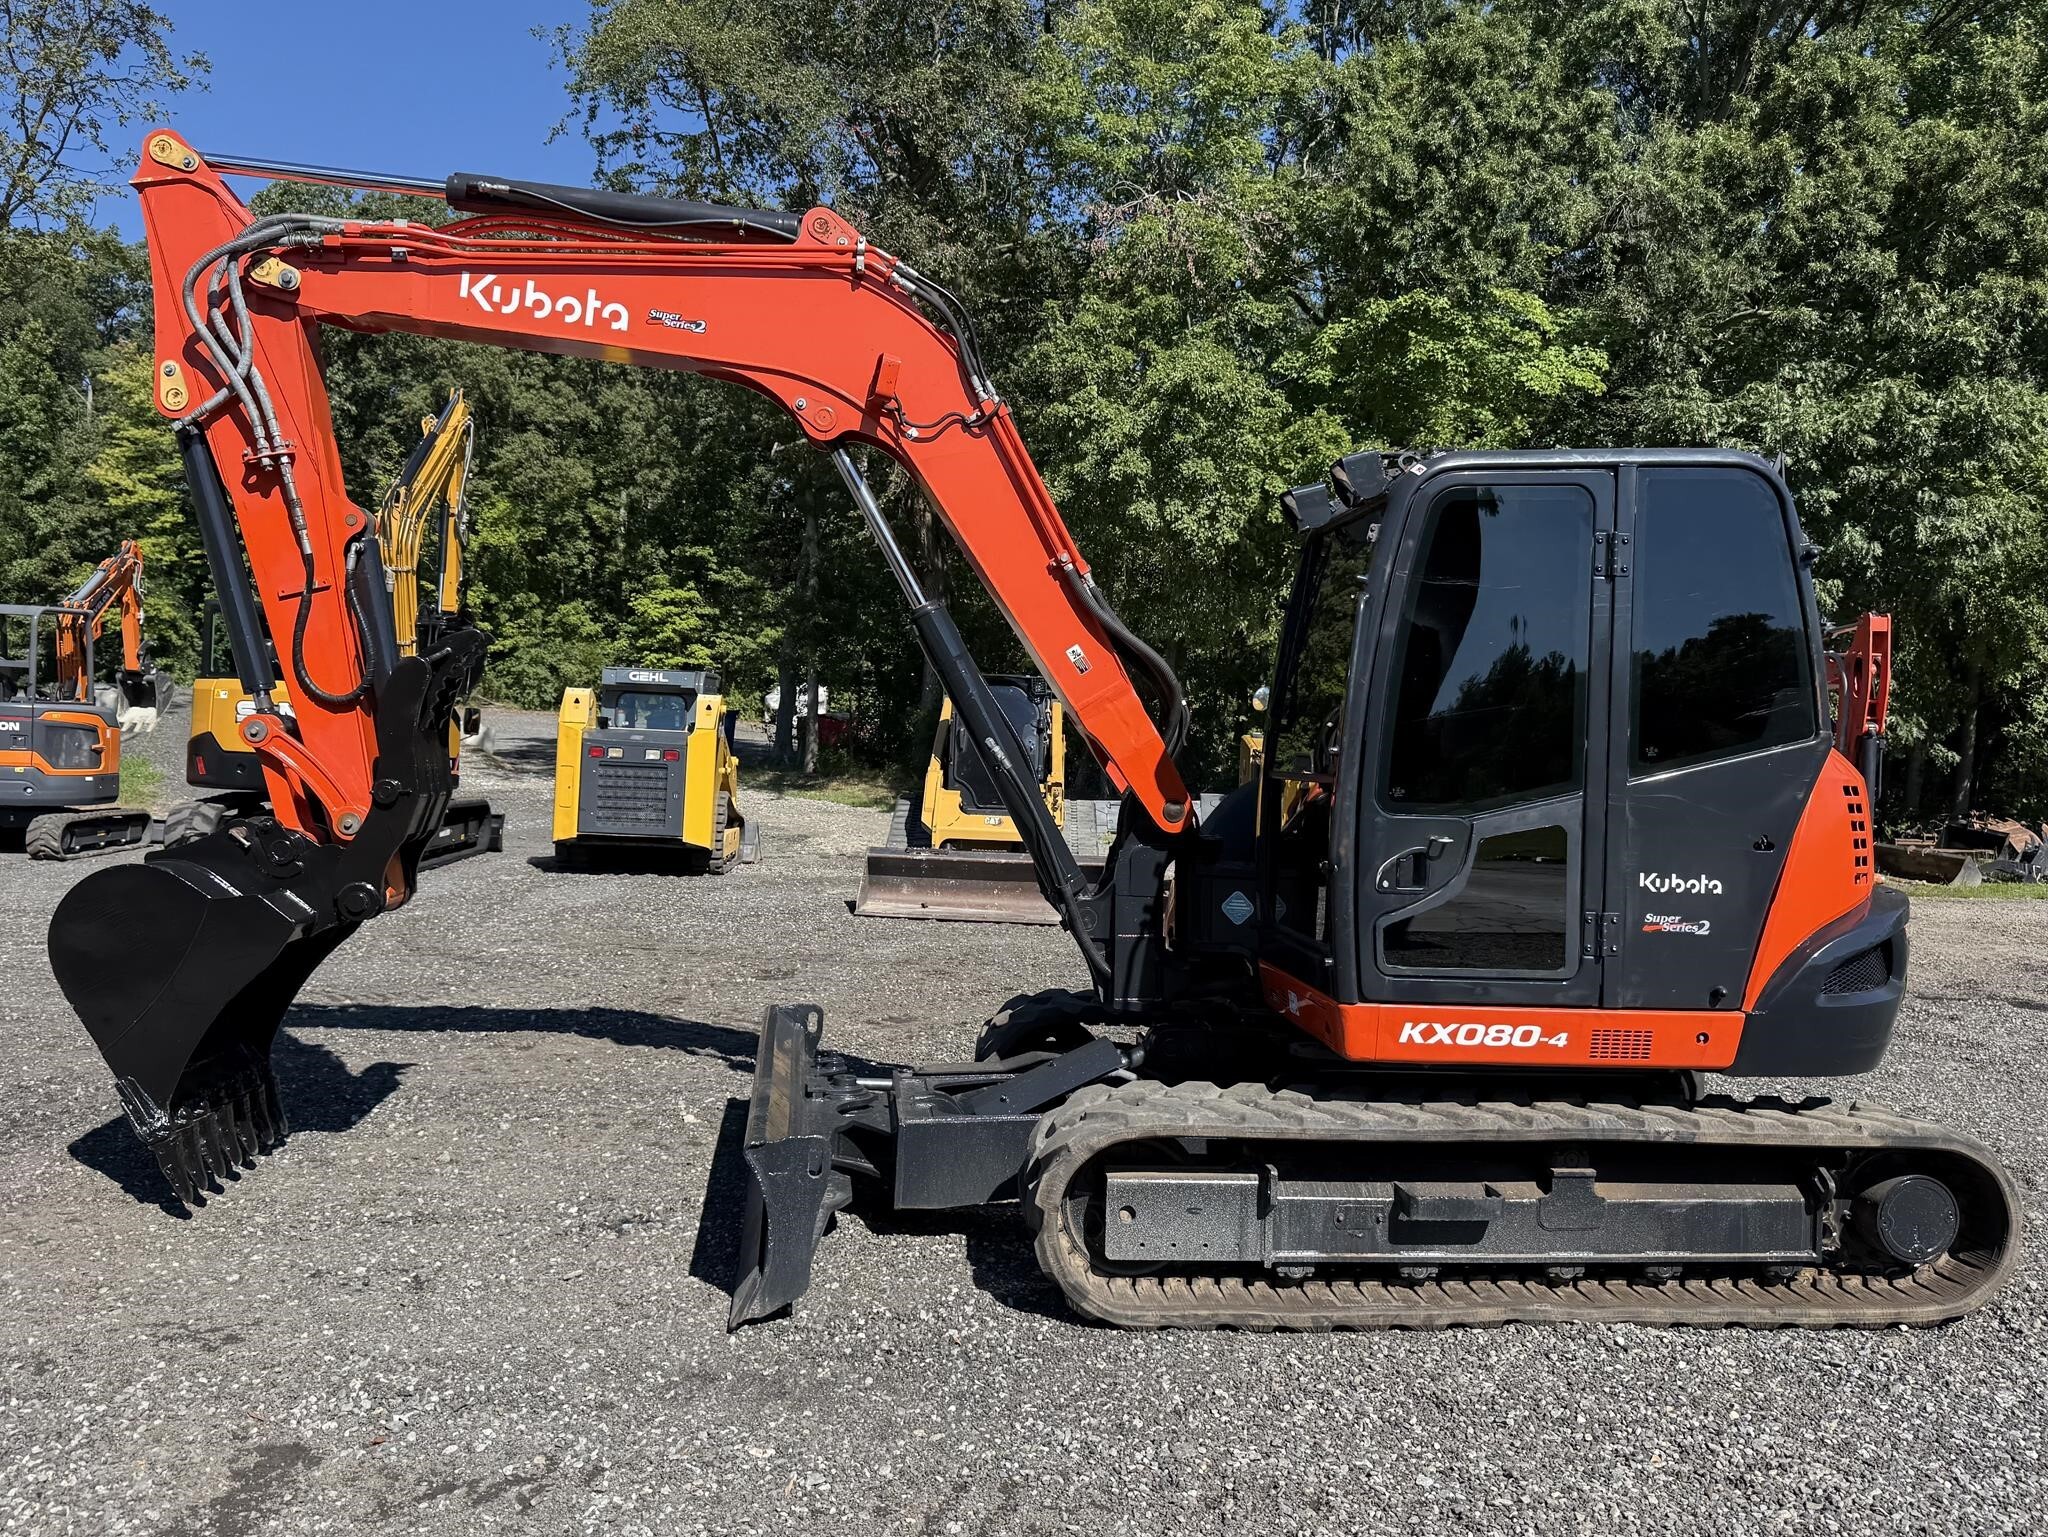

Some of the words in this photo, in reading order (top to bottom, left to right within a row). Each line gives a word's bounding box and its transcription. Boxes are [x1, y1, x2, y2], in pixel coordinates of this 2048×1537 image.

[459, 271, 629, 331] Kubota
[648, 309, 681, 321] Super
[628, 671, 669, 682] GEHL
[984, 815, 1001, 825] CAT
[1640, 872, 1723, 895] Kubota
[1644, 913, 1681, 924] Super
[1399, 1022, 1568, 1048] KX080-4
